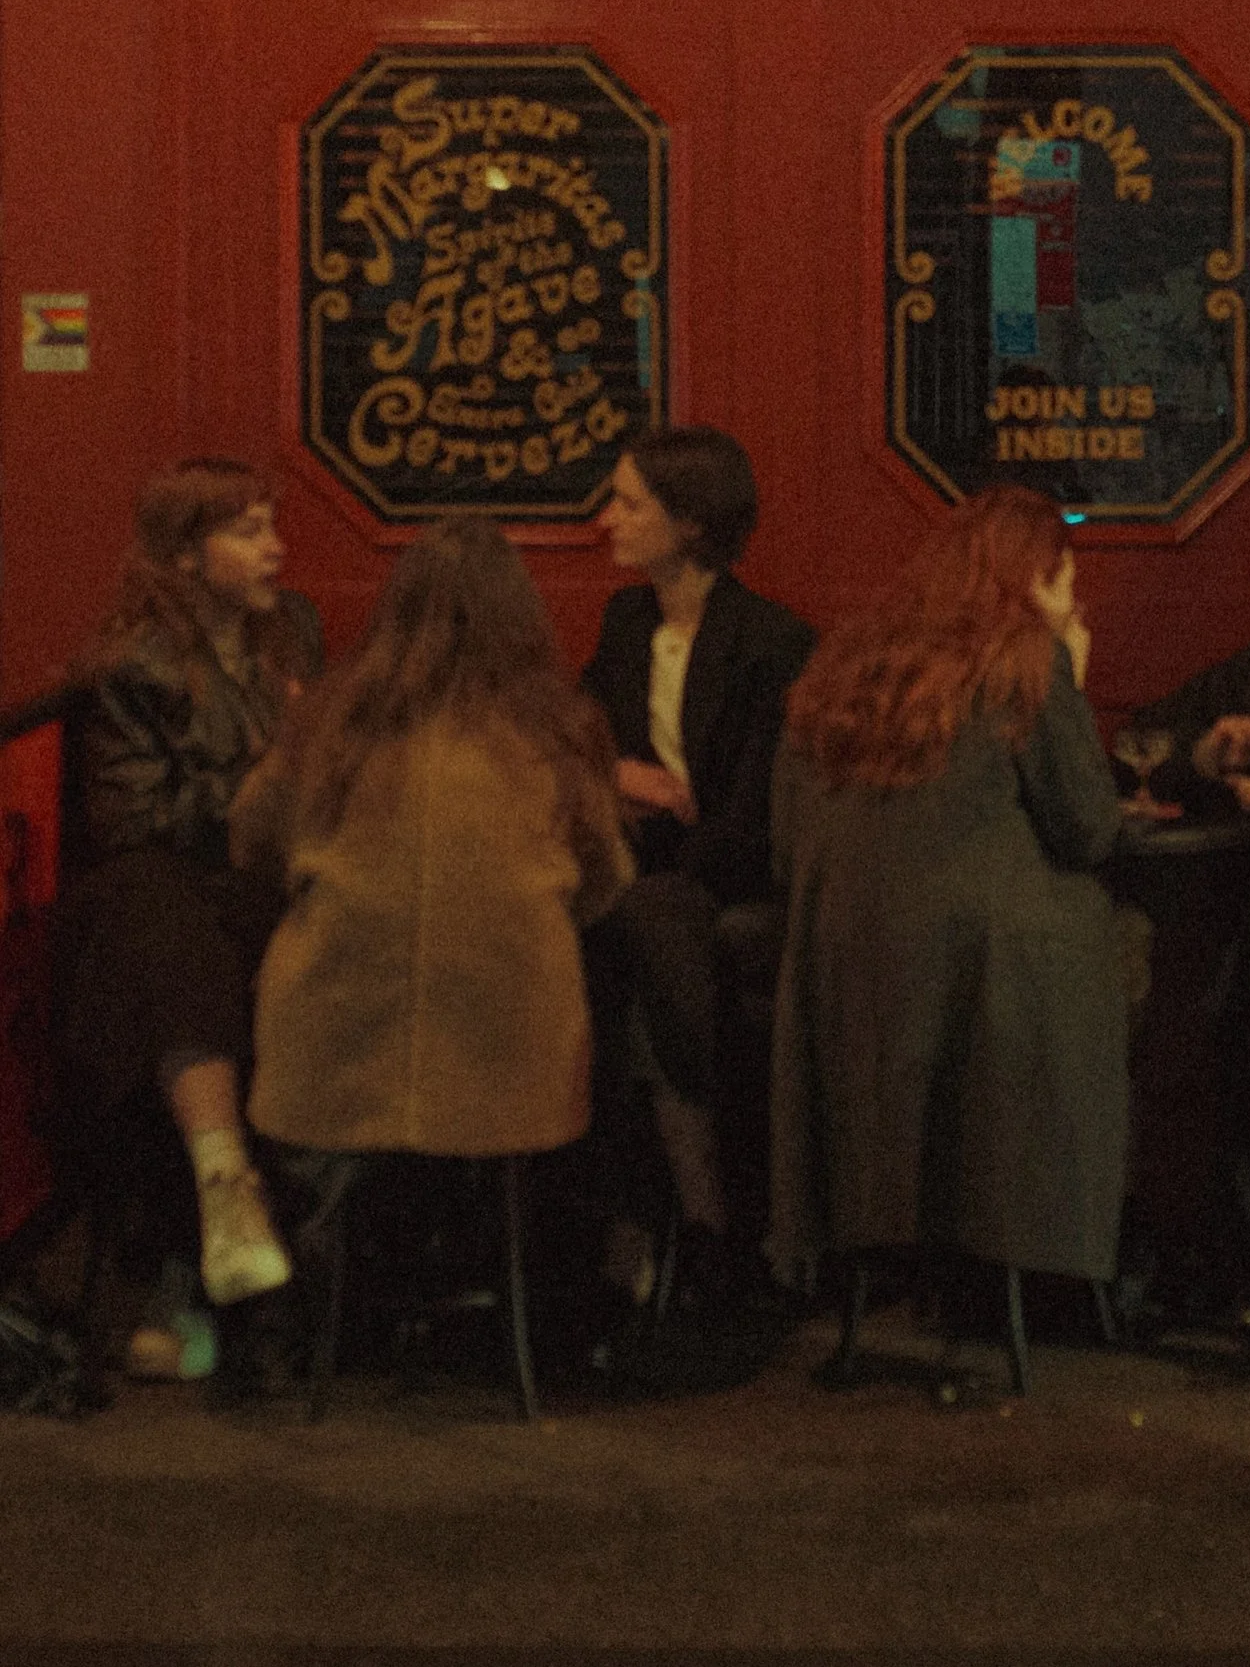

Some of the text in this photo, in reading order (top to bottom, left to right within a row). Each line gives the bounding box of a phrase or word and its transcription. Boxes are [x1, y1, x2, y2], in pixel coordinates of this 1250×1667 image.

[380, 75, 581, 169] Super
[988, 98, 1153, 202] WELCOME
[337, 151, 627, 286] Margaritas
[371, 264, 599, 372] Agave
[501, 328, 553, 381] &
[349, 375, 628, 481] Cerveza
[986, 385, 1156, 421] JOIN US
[995, 427, 1146, 462] INSIDE
